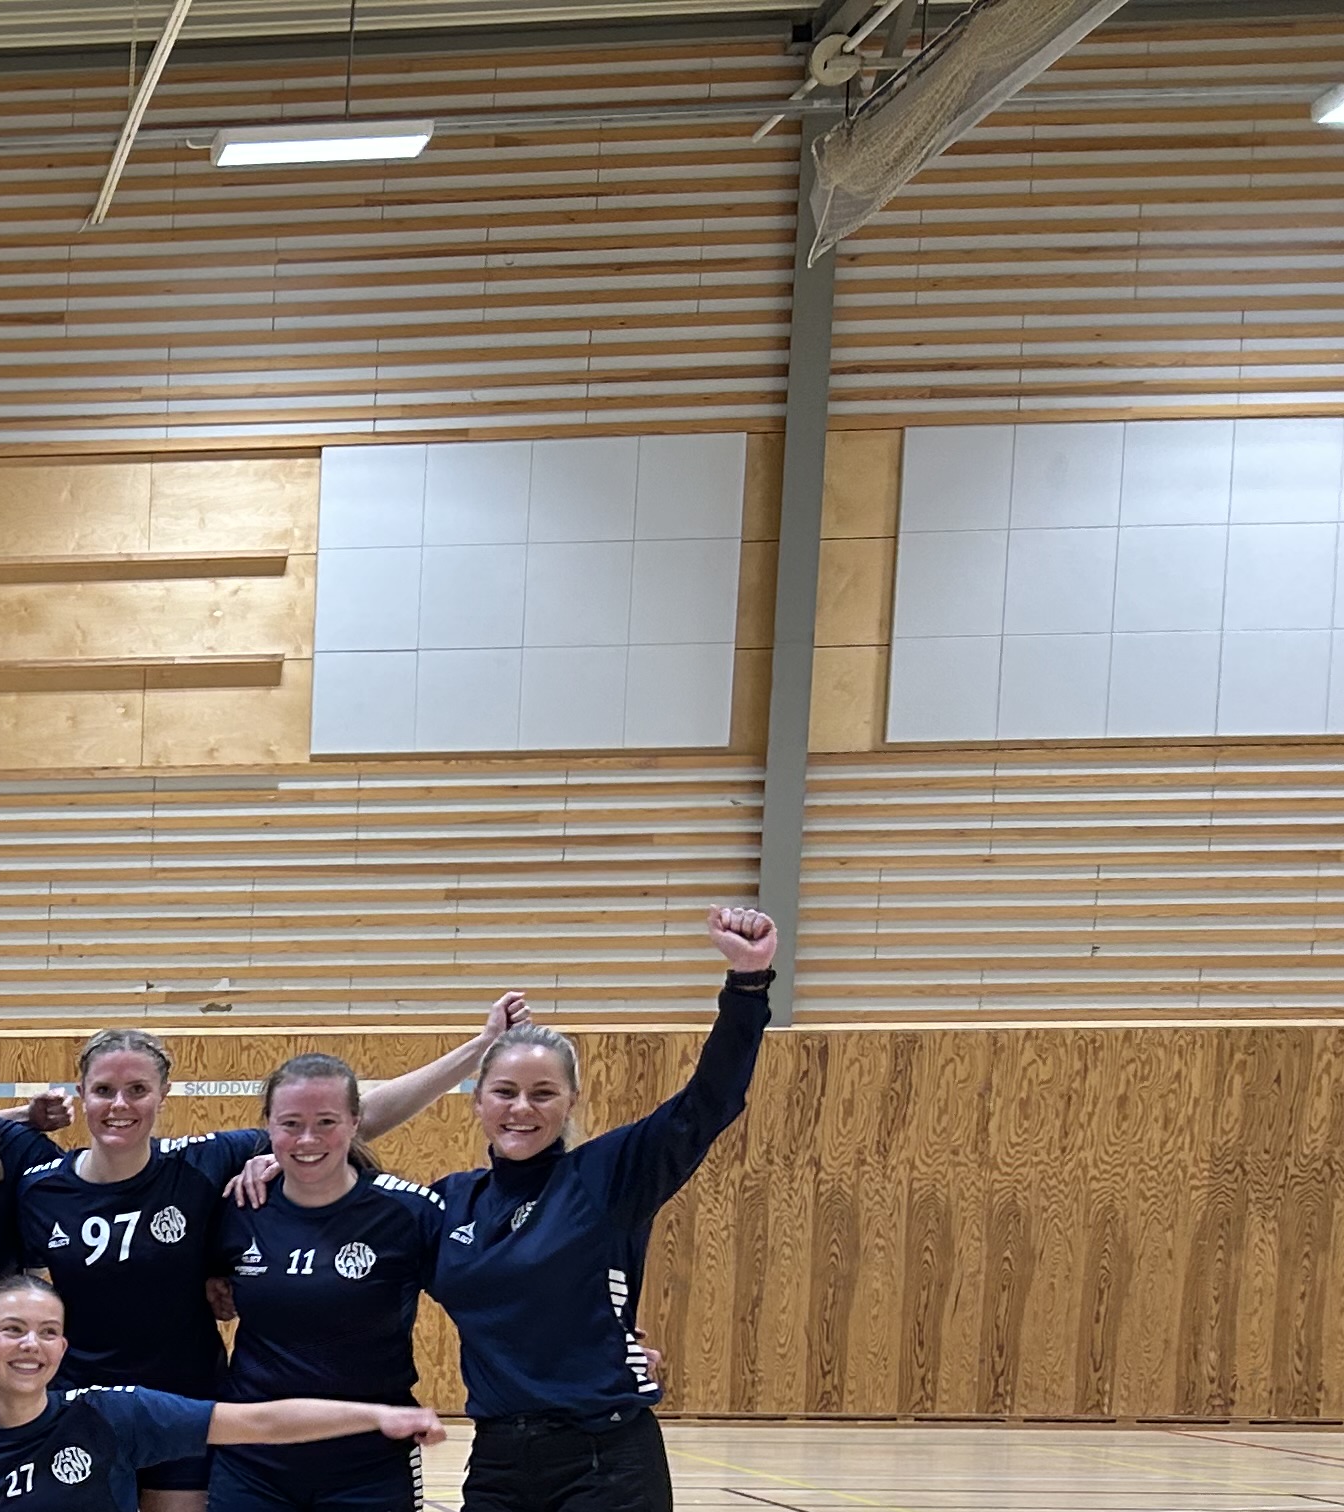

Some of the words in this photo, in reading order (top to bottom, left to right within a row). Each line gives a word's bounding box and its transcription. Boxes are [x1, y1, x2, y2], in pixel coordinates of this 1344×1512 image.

[184, 1082, 263, 1096] SKUDDVE
[81, 1210, 141, 1266] 97
[286, 1249, 316, 1274] 11
[6, 1463, 34, 1497] 27
